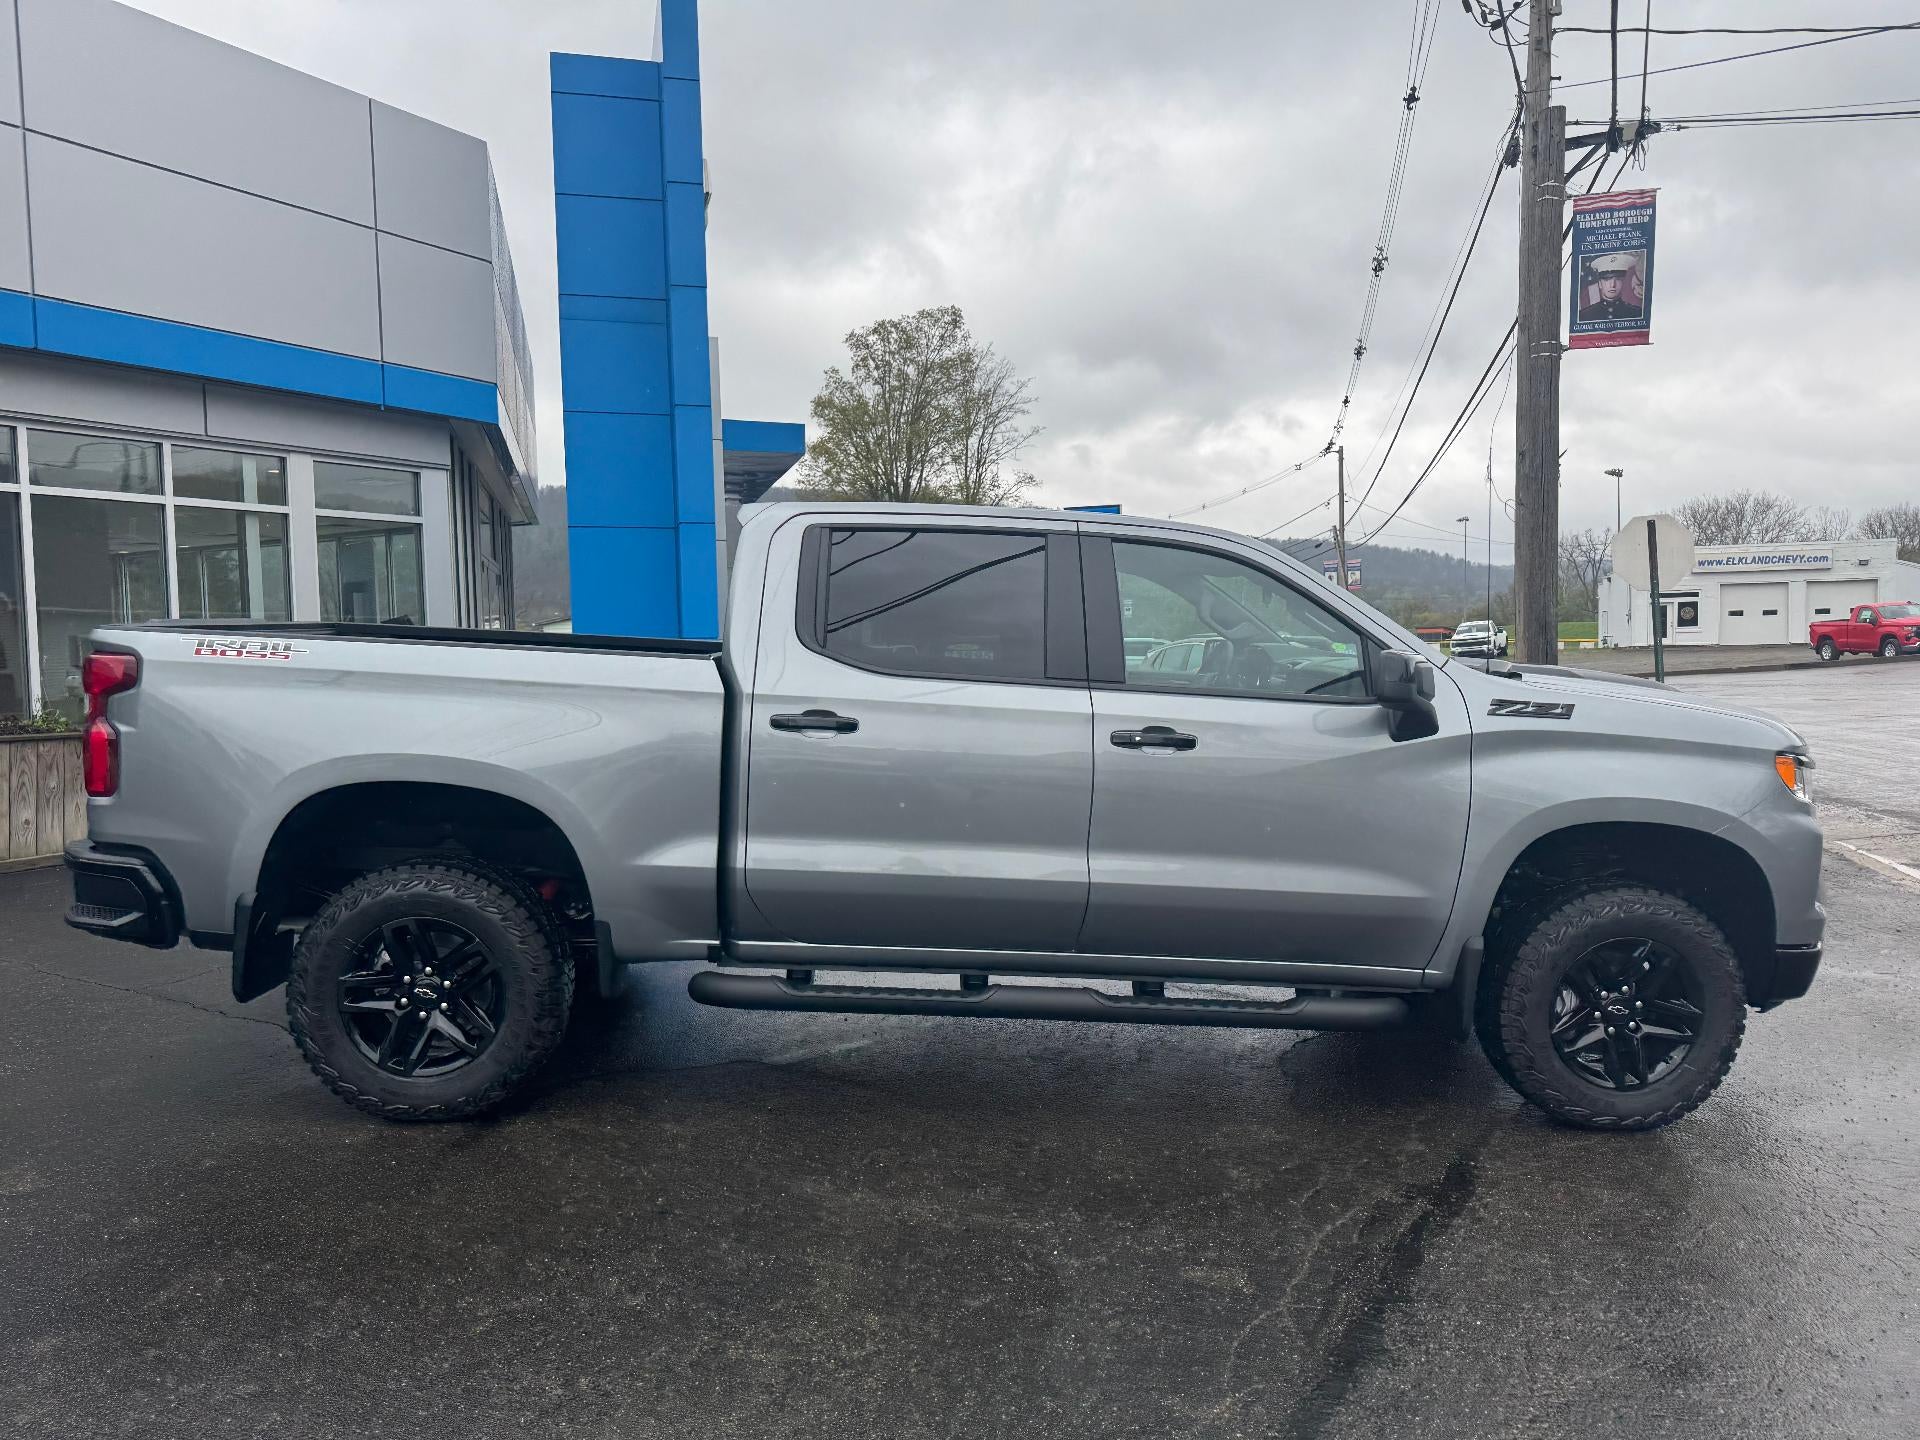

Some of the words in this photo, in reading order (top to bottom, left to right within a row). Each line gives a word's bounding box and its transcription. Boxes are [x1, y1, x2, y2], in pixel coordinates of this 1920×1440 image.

[1576, 211, 1611, 222] ELKLAND
[1613, 208, 1653, 218] BOROUGH
[1579, 217, 1625, 229] HOMETOWN
[1627, 215, 1649, 225] HERO
[1585, 233, 1617, 242] MICHAEL
[1594, 241, 1621, 250] MARINE
[1623, 238, 1647, 247] CORPS
[1697, 554, 1829, 567] www.ELKLANDCHEVY.com
[182, 638, 309, 654] TRAIL
[194, 647, 291, 660] BOSS
[1487, 698, 1576, 720] Z71
